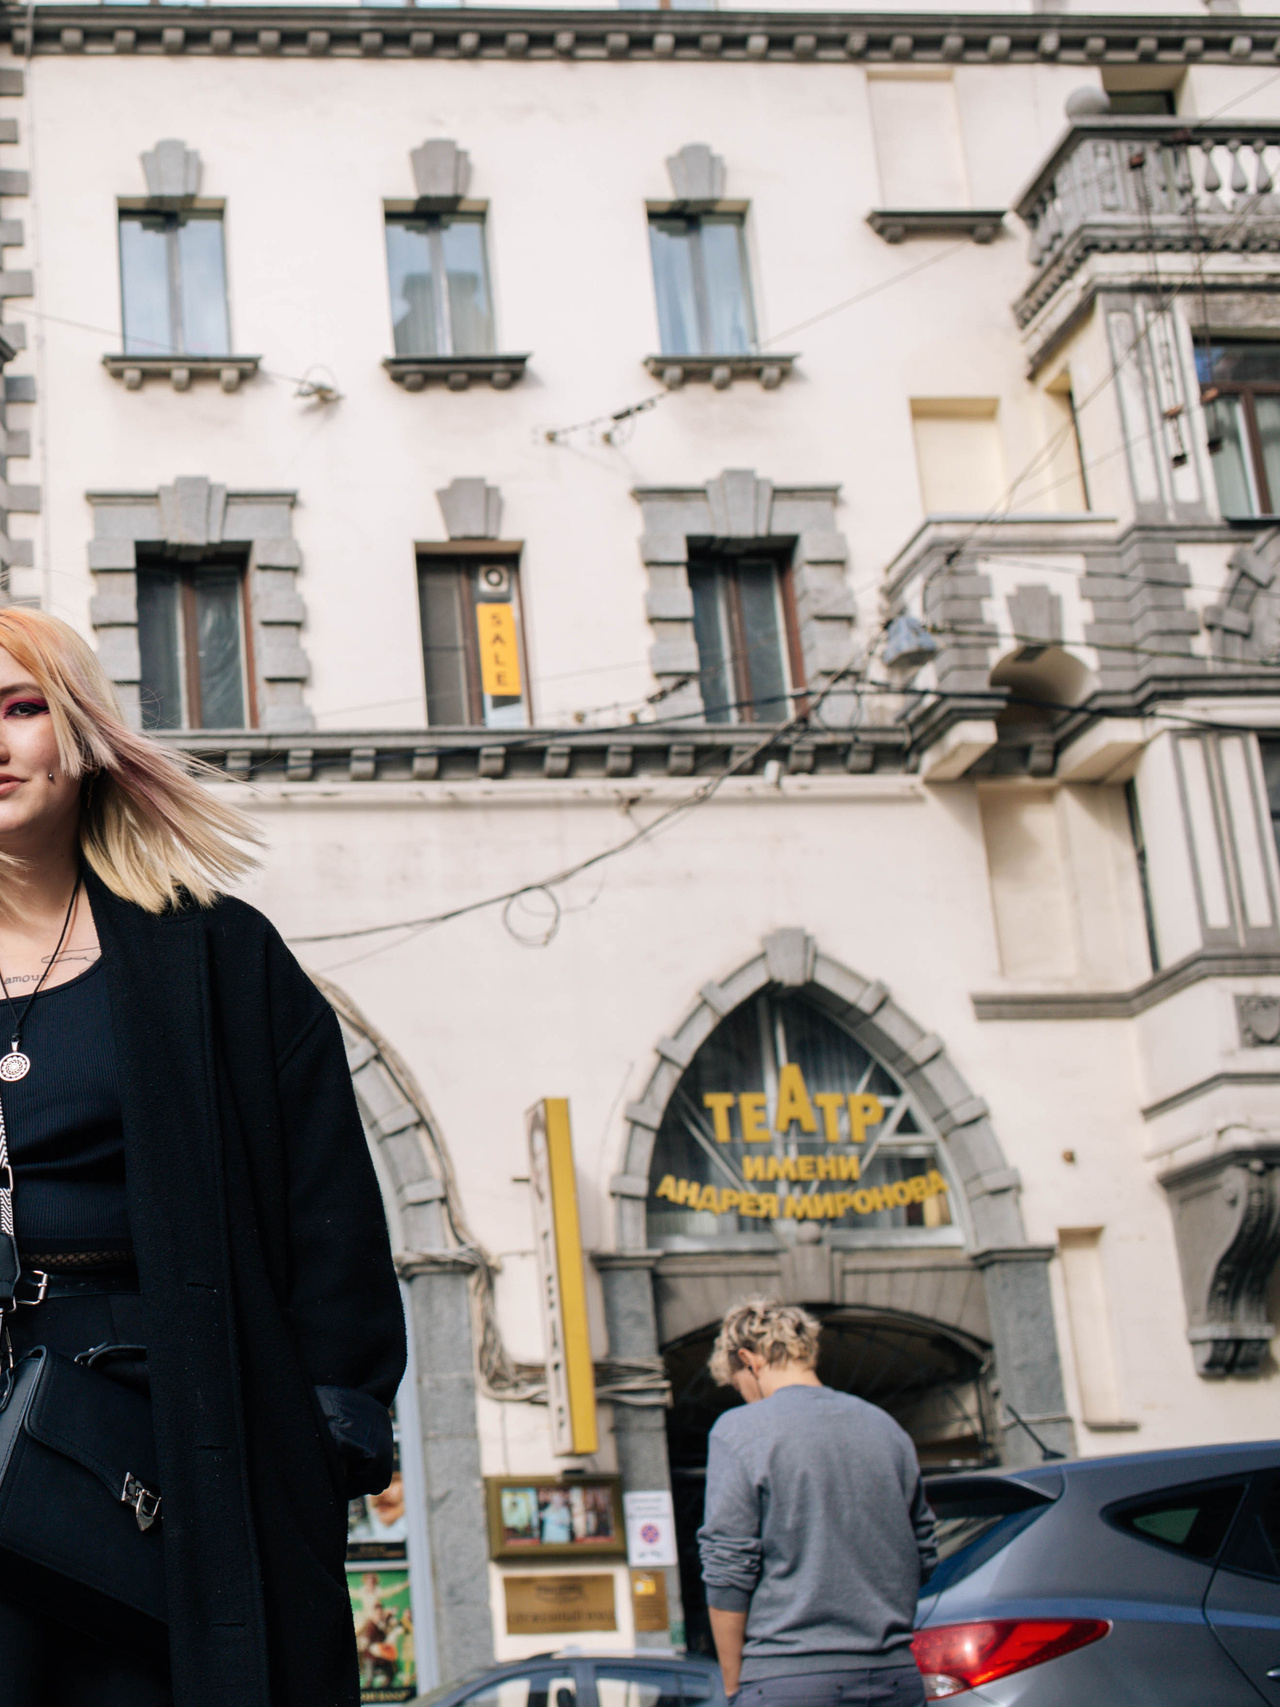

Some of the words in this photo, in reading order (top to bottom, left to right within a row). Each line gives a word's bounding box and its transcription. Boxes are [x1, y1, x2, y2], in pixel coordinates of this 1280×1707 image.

[490, 612, 507, 687] SALE
[703, 1062, 885, 1143] ТЕАТР
[656, 1174, 781, 1219] АНДРЕЯ
[783, 1169, 948, 1220] МИРОНОВА
[742, 1155, 860, 1181] ИМЕНИ
